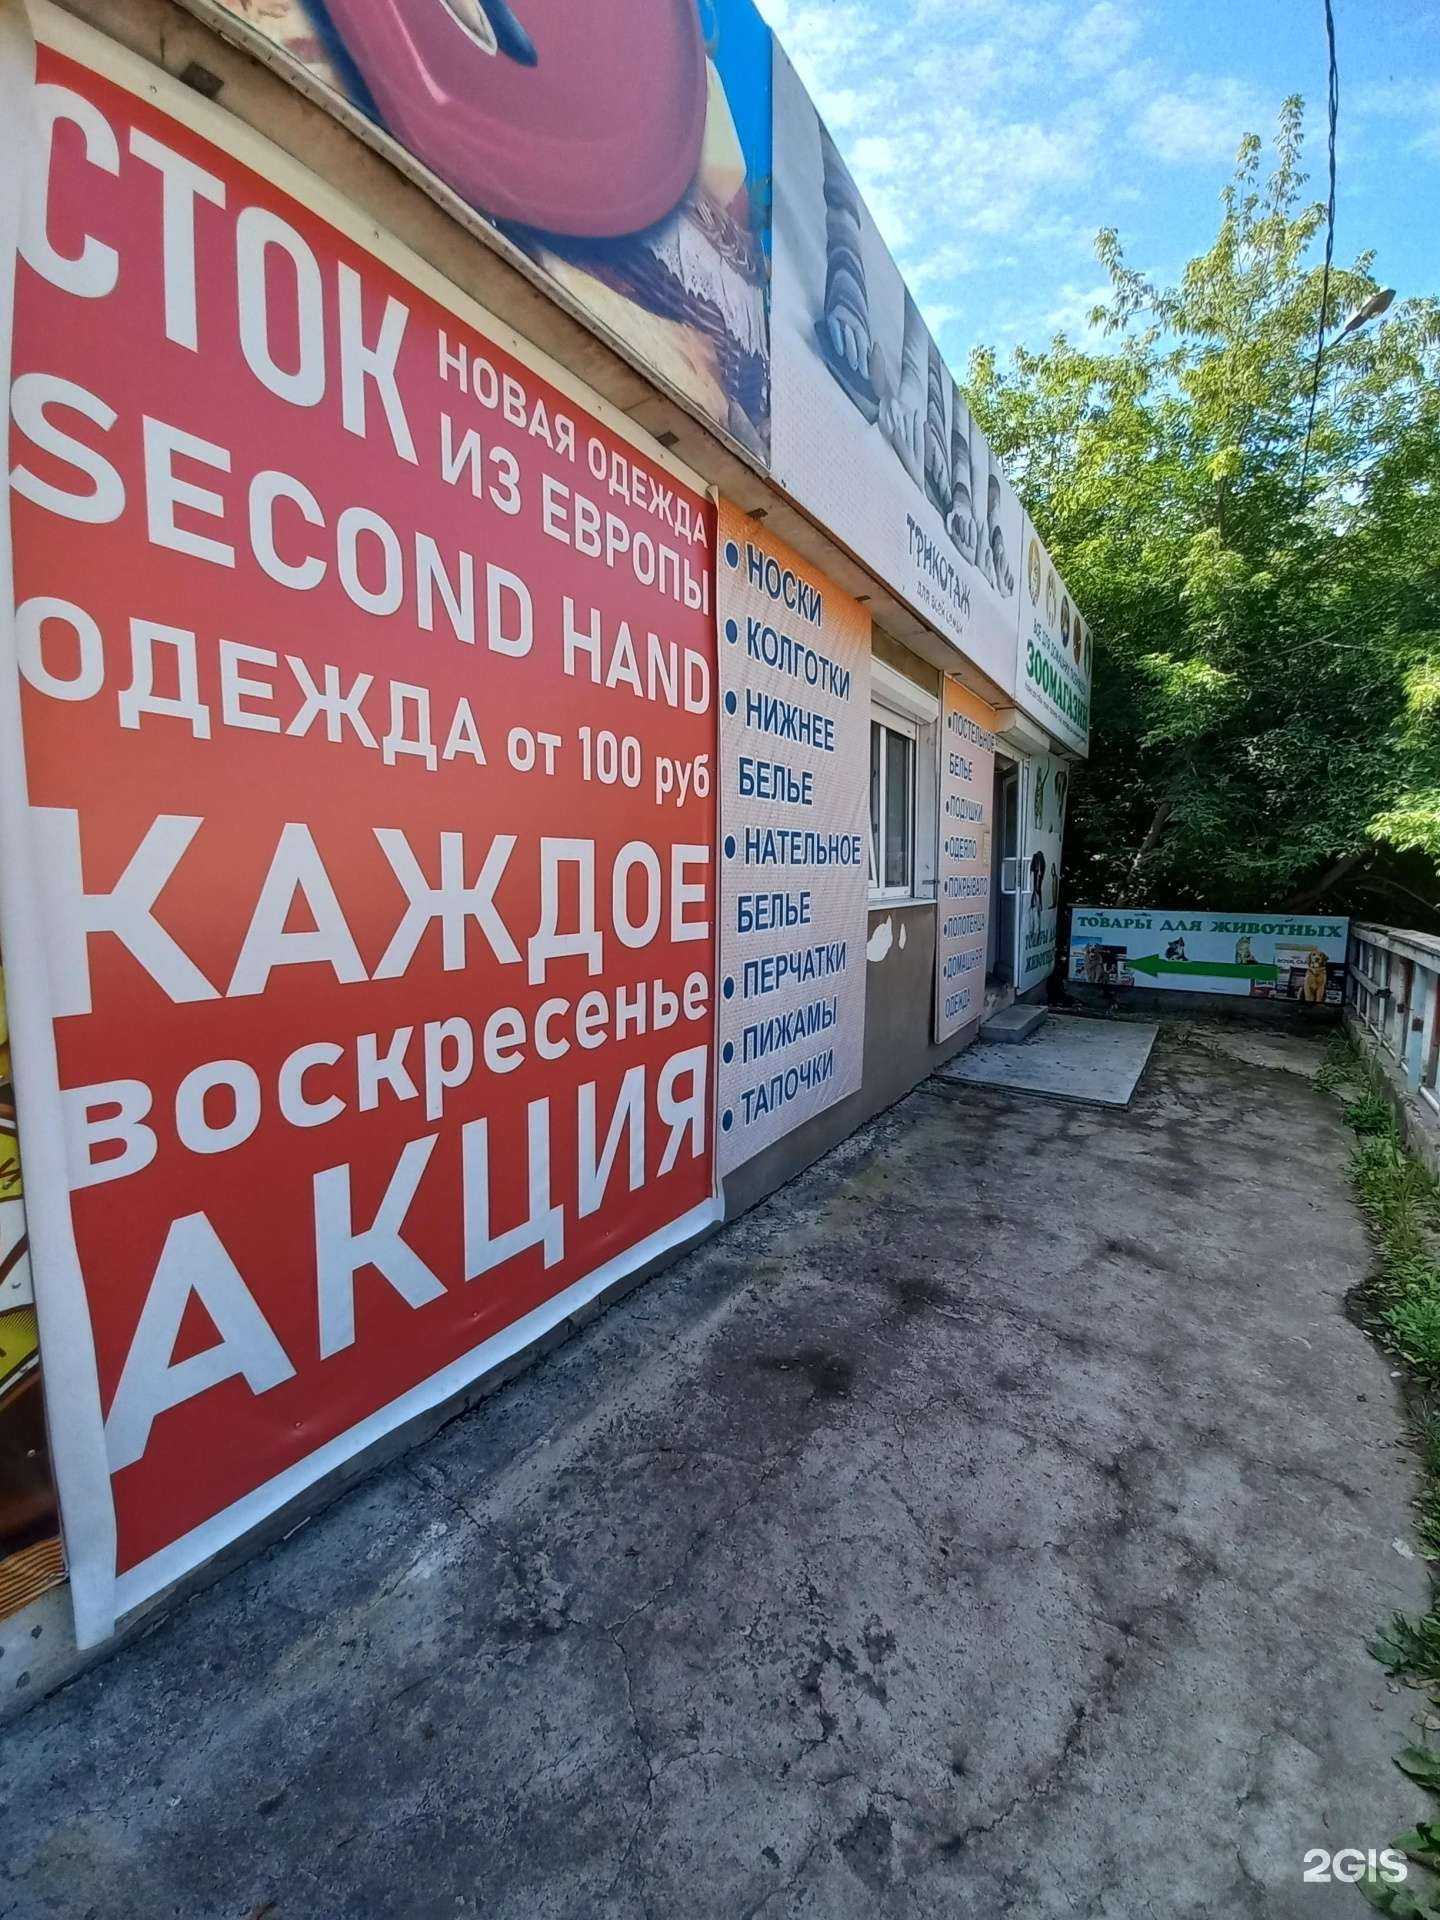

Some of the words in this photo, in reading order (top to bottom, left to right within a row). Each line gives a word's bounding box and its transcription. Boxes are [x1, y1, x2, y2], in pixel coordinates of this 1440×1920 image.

[16, 83, 419, 466] СТОК
[438, 328, 575, 463] НОВАЯ
[587, 437, 708, 548] ОДЕЖДА
[9, 372, 534, 659] SECOND
[562, 595, 711, 715] HAND
[440, 411, 521, 516] ИЗ
[541, 472, 709, 616] ЕВРОПЫ
[746, 543, 823, 628] НОСКИ
[746, 616, 851, 702] КОЛГОТКИ
[15, 596, 487, 771] ОДЕЖДА
[507, 726, 562, 776] от
[578, 726, 641, 788] 100
[655, 753, 710, 808] руб
[745, 688, 835, 752] НИЖНЕЕ
[952, 711, 995, 754] ПОСТЕЛЬНОЕ
[738, 756, 813, 806] БЕЛЬЕ
[949, 752, 973, 782] БЕЛЬЕ
[745, 827, 862, 865] НАТЕЛЬНОЕ
[949, 795, 983, 824] ПОДУШКИ
[30, 805, 711, 1017] КАЖДОЕ
[737, 891, 811, 934] БЕЛЬЕ
[1076, 915, 1152, 930] ТОВАРЫ
[1159, 918, 1202, 932] ДЛЯ
[1209, 920, 1343, 938] ЖИВОТНЫХ
[743, 941, 847, 1000] ПЕРЧАТКИ
[742, 995, 838, 1065] ПИЖАМЫ
[60, 970, 709, 1193] воскресенье
[740, 1048, 834, 1126] ТАПОЧКИ
[104, 1044, 709, 1475] АКЦИЯ
